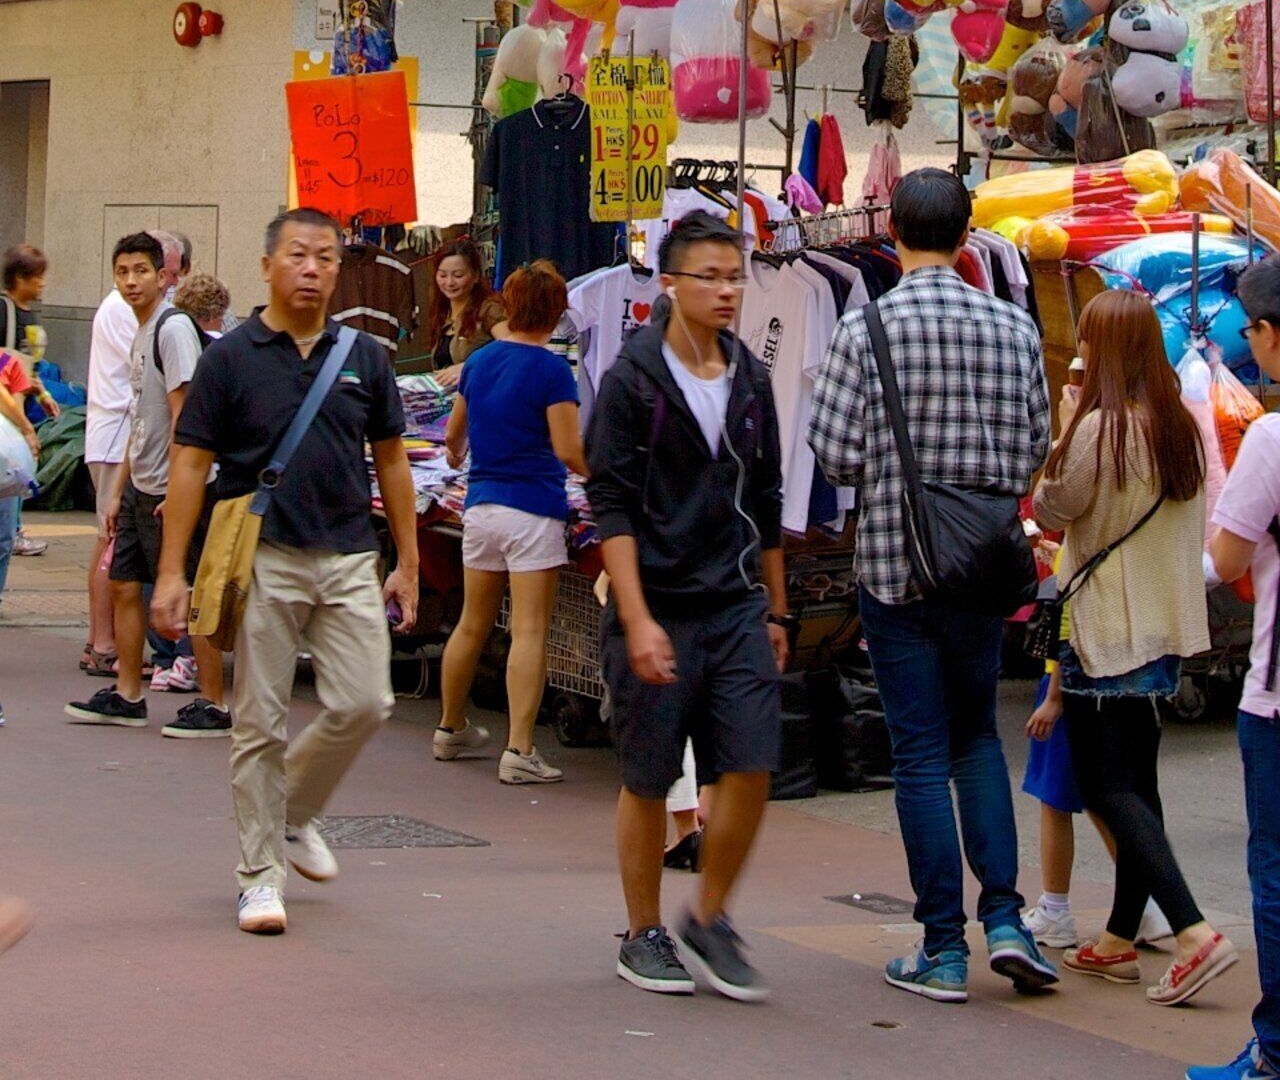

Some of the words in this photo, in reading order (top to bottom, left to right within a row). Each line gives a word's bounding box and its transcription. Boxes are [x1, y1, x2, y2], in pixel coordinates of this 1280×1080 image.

[327, 131, 362, 188] 3
[594, 126, 605, 162] 1
[594, 167, 609, 205] 4
[622, 298, 632, 320] I
